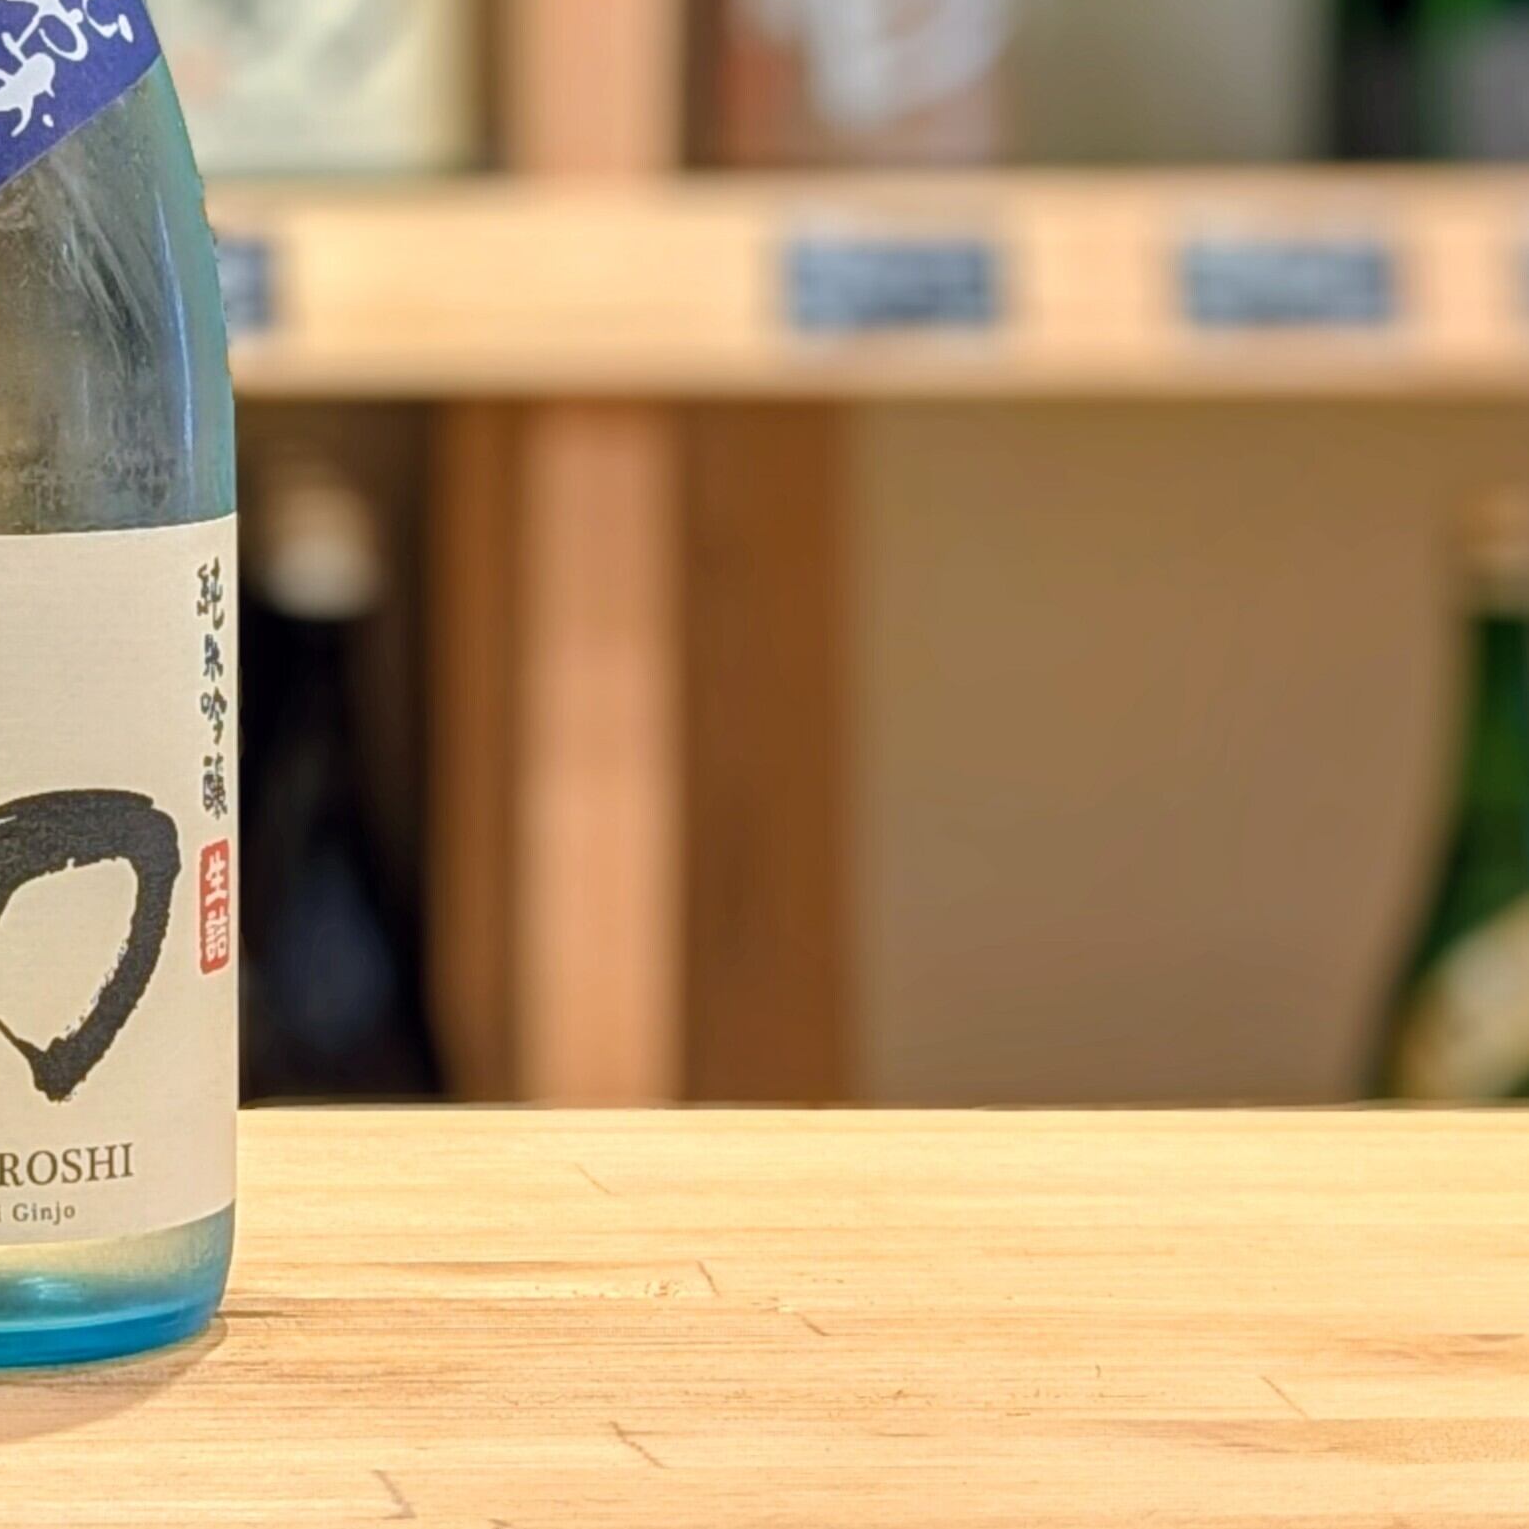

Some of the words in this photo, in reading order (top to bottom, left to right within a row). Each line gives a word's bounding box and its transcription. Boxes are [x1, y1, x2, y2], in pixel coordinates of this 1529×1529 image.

[196, 556, 229, 821] 純米吟醸
[11, 1200, 77, 1226] Ginjo
